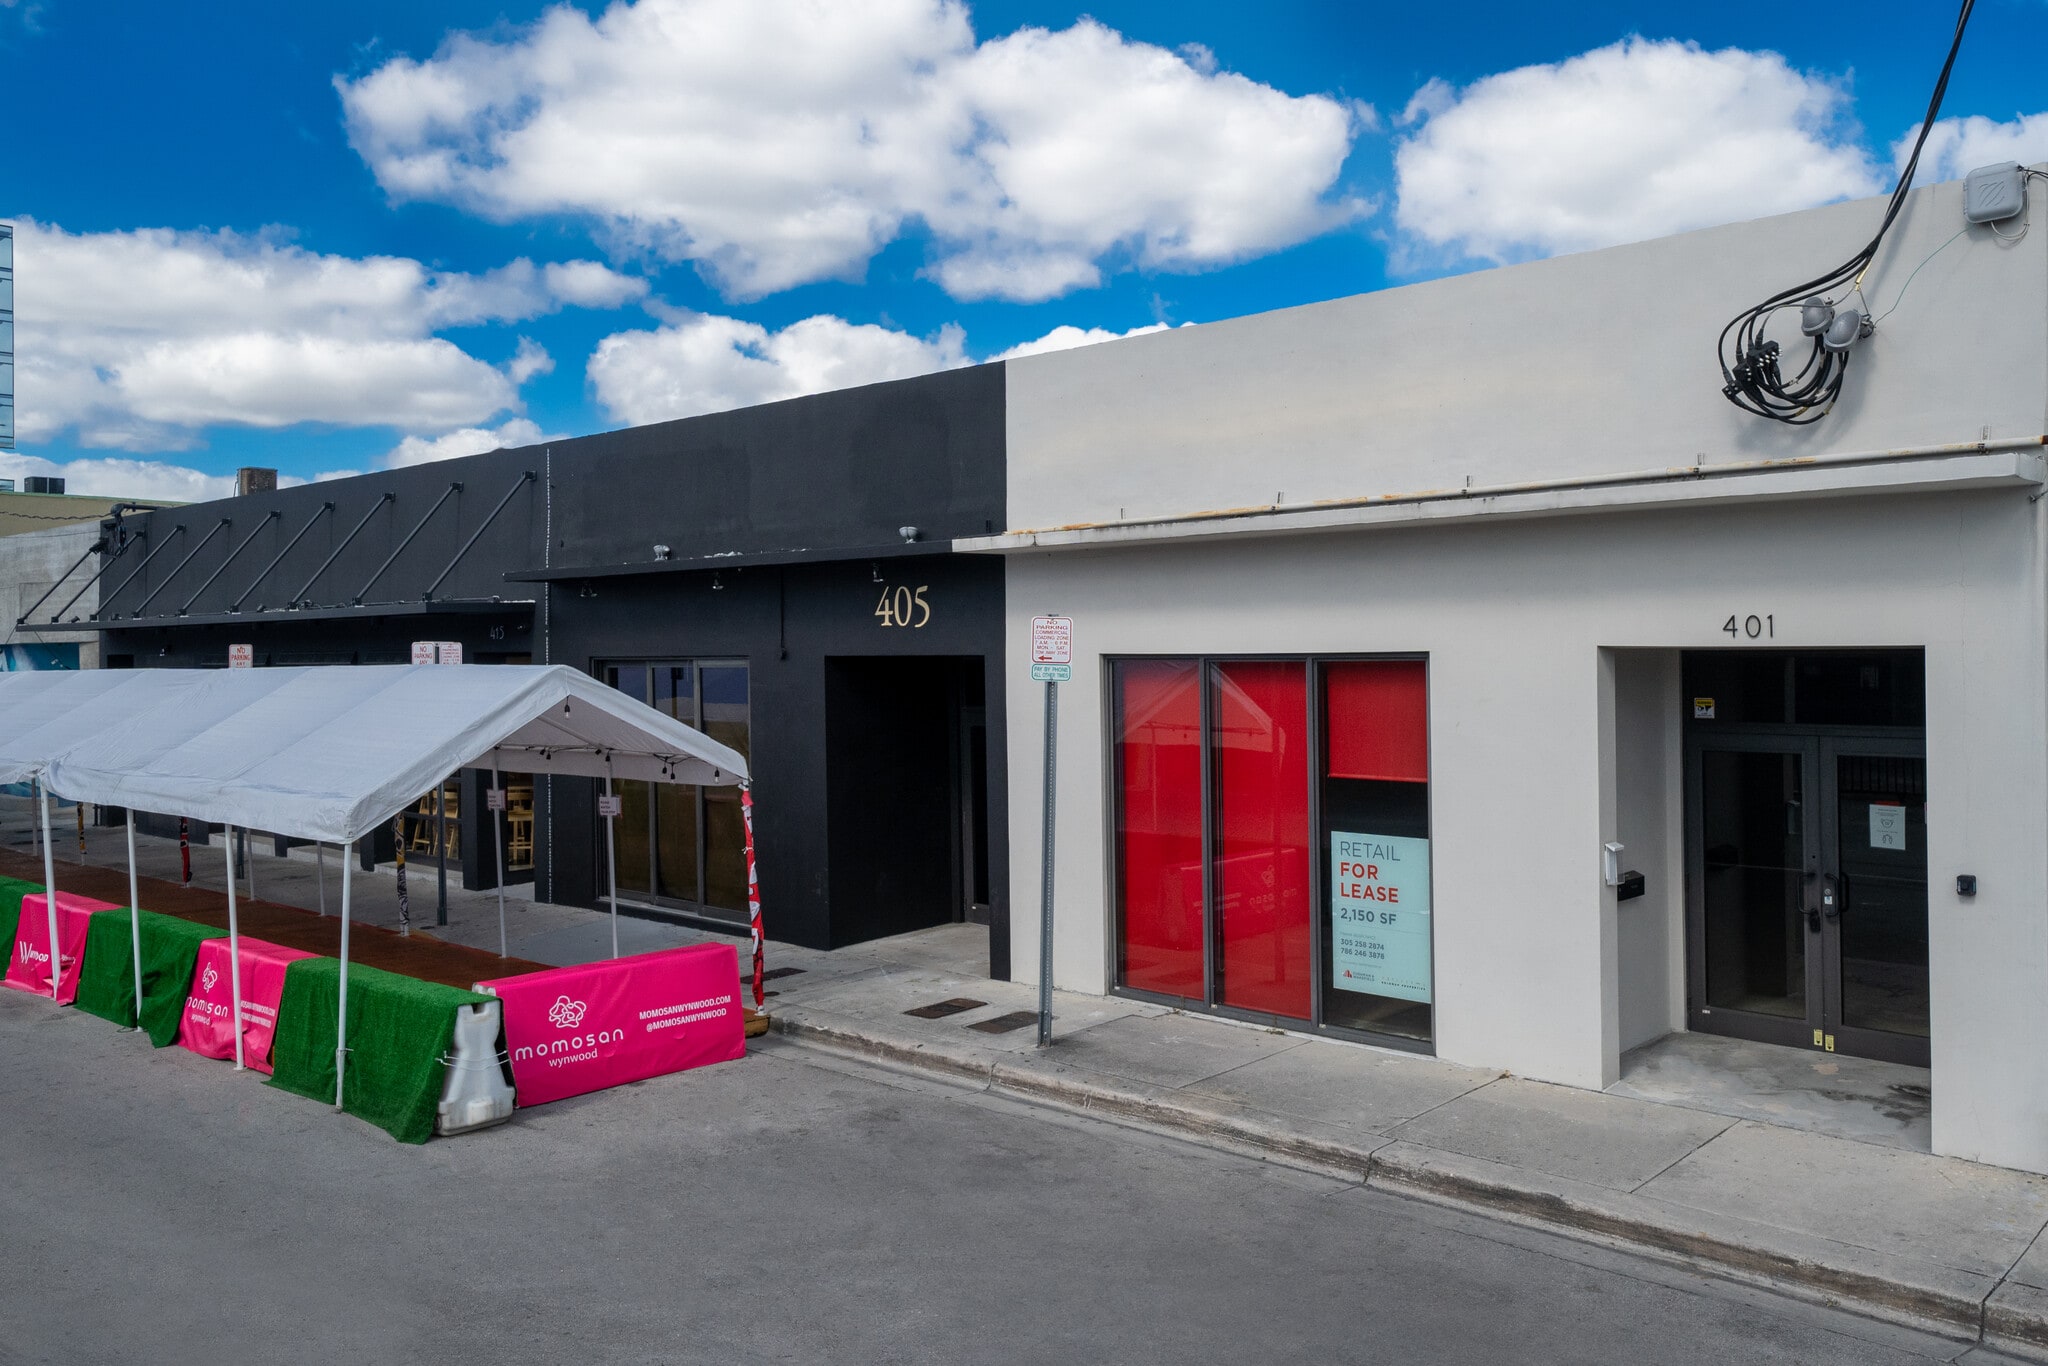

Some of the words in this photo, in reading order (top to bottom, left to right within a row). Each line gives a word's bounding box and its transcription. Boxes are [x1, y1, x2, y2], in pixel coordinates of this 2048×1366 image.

[875, 586, 930, 628] 405
[490, 625, 505, 640] 415
[1722, 614, 1774, 639] 401
[1340, 841, 1401, 861] RETAIL
[1340, 862, 1379, 881] FOR
[1340, 882, 1399, 904] LEASE
[1340, 907, 1375, 923] 2,150
[1380, 912, 1397, 926] SF
[1340, 938, 1353, 946] 305
[639, 995, 731, 1020] MOMOSANWYNWOOD.COM
[646, 1008, 727, 1033] @MOMOSANWYNWOOD
[515, 1028, 624, 1061] momosan
[549, 1048, 598, 1068] wynwood
